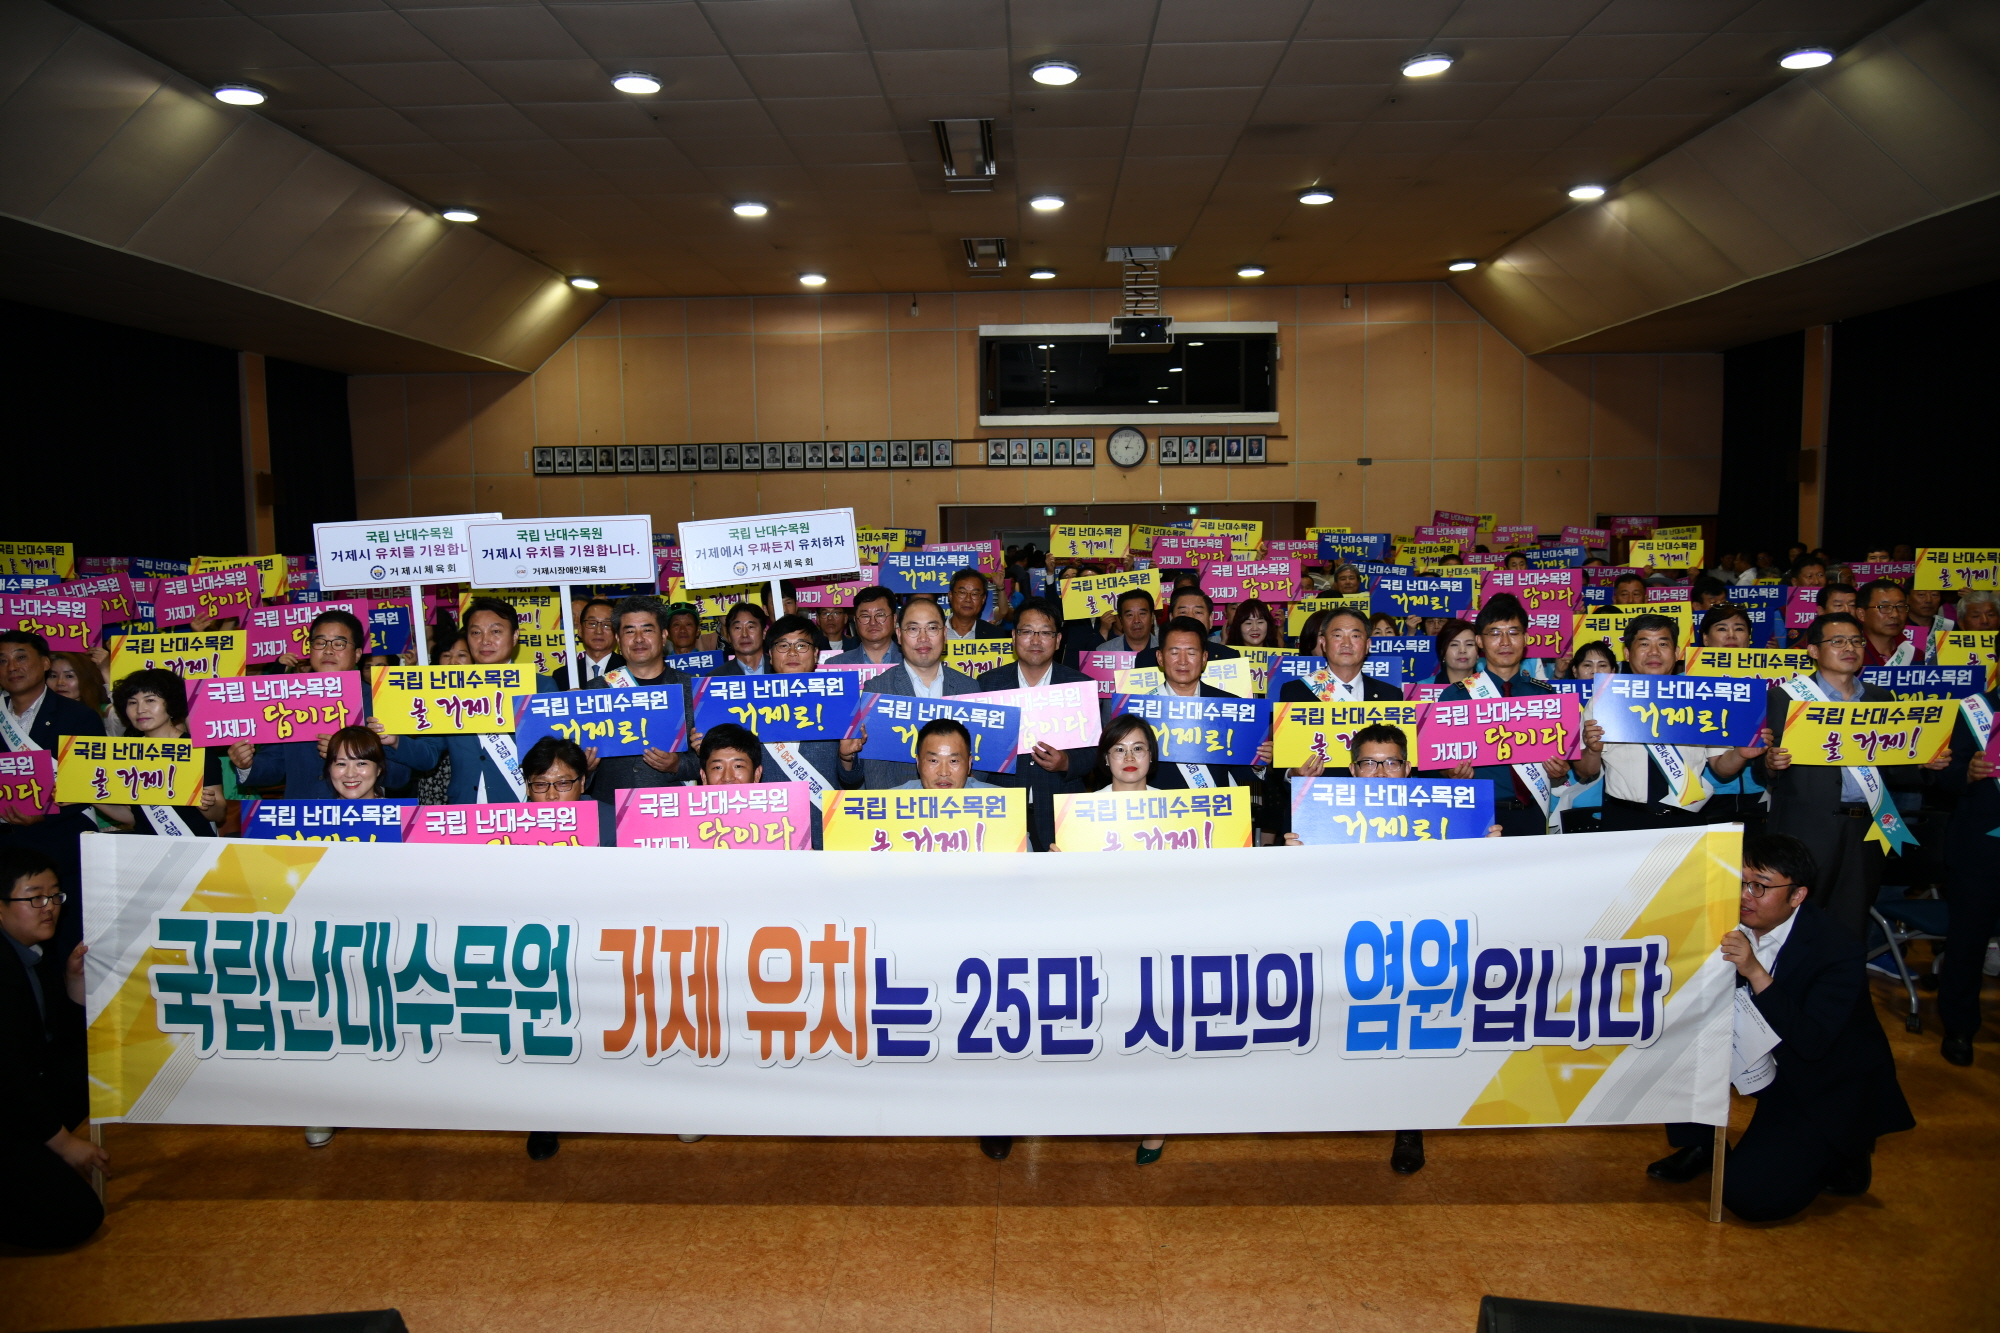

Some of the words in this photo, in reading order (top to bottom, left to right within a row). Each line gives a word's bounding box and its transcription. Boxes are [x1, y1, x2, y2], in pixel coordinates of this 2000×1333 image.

[366, 531, 389, 543] 국립
[394, 527, 453, 542] 난대수목원
[517, 529, 540, 542] 국립
[544, 527, 602, 541] 난대수목원
[729, 528, 750, 540] 국립
[755, 522, 810, 538] 난대수목원
[1059, 527, 1075, 536] 국립
[1079, 527, 1121, 536] 난대수목원
[1200, 522, 1215, 530] 국립
[1218, 522, 1256, 531] 난대수목원
[1580, 528, 1605, 537] 난대수목원
[1669, 527, 1697, 535] 난대수목원
[857, 533, 898, 541] 난대수목원
[1162, 539, 1178, 548] 국립
[1182, 539, 1222, 548] 난대수목원
[1272, 541, 1285, 550] 국립
[1325, 535, 1339, 543] 국립
[1341, 535, 1377, 543] 난대수목원
[17, 545, 64, 555] 난대수목원
[331, 549, 371, 562] 거제시
[376, 546, 415, 560] 유치를
[482, 548, 521, 560] 거제시
[526, 545, 565, 558] 유치를
[570, 544, 640, 557] 기원합니다.
[695, 545, 743, 559] 거제에서
[748, 540, 795, 555] 우짜든지
[798, 535, 845, 550] 유치하자
[1082, 539, 1113, 555] 거제!
[1331, 544, 1368, 558] 거제로!
[1542, 550, 1579, 558] 난대수목원
[21, 557, 56, 574] 거제!
[136, 559, 153, 569] 국립
[889, 555, 910, 567] 국립
[915, 555, 969, 566] 난대수목원
[1159, 556, 1182, 565] 거제가
[1186, 550, 1225, 566] 답이다
[1468, 555, 1481, 563] 국립
[1660, 551, 1689, 567] 거제!
[1927, 552, 1948, 563] 국립
[533, 566, 606, 575] 거제시장애인체육회
[1211, 564, 1232, 577] 국립
[1237, 563, 1289, 576] 난대수목원
[1368, 565, 1407, 575] 난대수목원
[1852, 564, 1870, 574] 국립
[1939, 569, 1952, 588] 올
[1956, 566, 1997, 588] 거제!
[64, 577, 120, 598] 난대수목원
[164, 580, 187, 595] 국립
[192, 571, 247, 592] 난대수목원
[1071, 580, 1092, 592] 국립
[1096, 573, 1150, 590] 난대수목원
[1209, 587, 1238, 598] 거제가
[1242, 577, 1292, 598] 답이다
[1380, 579, 1402, 590] 국립
[1407, 580, 1462, 591] 난대수목원
[1493, 574, 1513, 586] 국립
[1518, 572, 1571, 586] 난대수목원
[298, 592, 318, 602] 국립
[709, 589, 749, 613] 거제!
[1523, 587, 1574, 609] 답이다
[1729, 588, 1779, 599] 난대수목원
[10, 599, 86, 618] 난대수목원
[164, 605, 196, 621] 거제가
[199, 588, 252, 617] 답이다
[1086, 596, 1099, 615] 올
[1298, 602, 1316, 612] 국립
[1391, 593, 1449, 613] 거제로!
[254, 610, 279, 627] 국립
[1585, 618, 1610, 630] 국립
[126, 639, 154, 654] 국립
[161, 636, 233, 653] 난대수목원
[252, 640, 287, 657] 거제가
[518, 635, 542, 647] 국립
[954, 643, 1013, 655] 난대수목원
[1369, 640, 1430, 653] 난대수목원
[1949, 635, 1973, 647] 국립
[534, 652, 548, 672] 올
[1092, 655, 1116, 669] 국립
[1282, 661, 1310, 676] 국립
[1701, 652, 1731, 667] 국립
[1738, 653, 1815, 669] 난대수목원
[389, 671, 422, 690] 국립
[430, 670, 520, 689] 난대수목원
[1129, 672, 1158, 688] 국립
[1863, 671, 1891, 686] 국립
[1897, 670, 1972, 686] 난대수목원
[208, 681, 245, 703] 국립
[252, 677, 342, 700] 난대수목원
[710, 681, 746, 700] 국립
[753, 677, 844, 698] 난대수목원
[1612, 680, 1650, 698] 국립
[1657, 680, 1750, 702] 난대수목원
[410, 698, 431, 730] 올
[436, 691, 504, 729] 거제!
[531, 698, 569, 717] 국립
[576, 691, 668, 714] 난대수목원
[1128, 699, 1162, 718] 국립
[1168, 702, 1255, 722] 난대수목원
[1435, 705, 1468, 726] 국립
[1476, 698, 1561, 724] 난대수목원
[205, 718, 256, 738] 거제가
[263, 700, 348, 739] 답이다
[728, 703, 824, 735] 거제로!
[877, 698, 912, 719] 국립
[919, 703, 1004, 728] 난대수목원
[1290, 708, 1324, 725] 국립
[1332, 707, 1416, 725] 난대수목원
[1629, 702, 1728, 737] 거제로!
[1806, 707, 1845, 724] 국립
[1850, 706, 1942, 725] 난대수목원
[551, 718, 649, 745] 거제로!
[1432, 741, 1477, 762] 거제가
[1484, 722, 1567, 760] 답이다
[1822, 732, 1843, 762] 올
[1853, 726, 1921, 761] 거제!
[74, 742, 106, 760] 국립
[113, 743, 191, 761] 난대수목원
[91, 766, 109, 800] 올
[117, 764, 176, 800] 거제!
[639, 793, 679, 817] 국립
[688, 788, 788, 815] 난대수목원
[1312, 784, 1355, 806] 국립
[1365, 785, 1475, 808] 난대수목원
[259, 805, 296, 826] 국립
[303, 804, 400, 827] 난대수목원
[844, 797, 887, 820] 국립
[896, 796, 1006, 819] 난대수목원
[1075, 799, 1118, 822] 국립
[1126, 794, 1232, 820] 난대수목원
[426, 811, 467, 835] 국립
[476, 807, 576, 834] 난대수목원
[156, 919, 573, 1056] 국립난대수목원
[599, 926, 720, 1059] 거제
[747, 924, 932, 1060] 유치는
[956, 956, 1100, 1056] 25만
[1124, 952, 1314, 1052] 시민의
[1344, 919, 1662, 1052] 염원입니다
